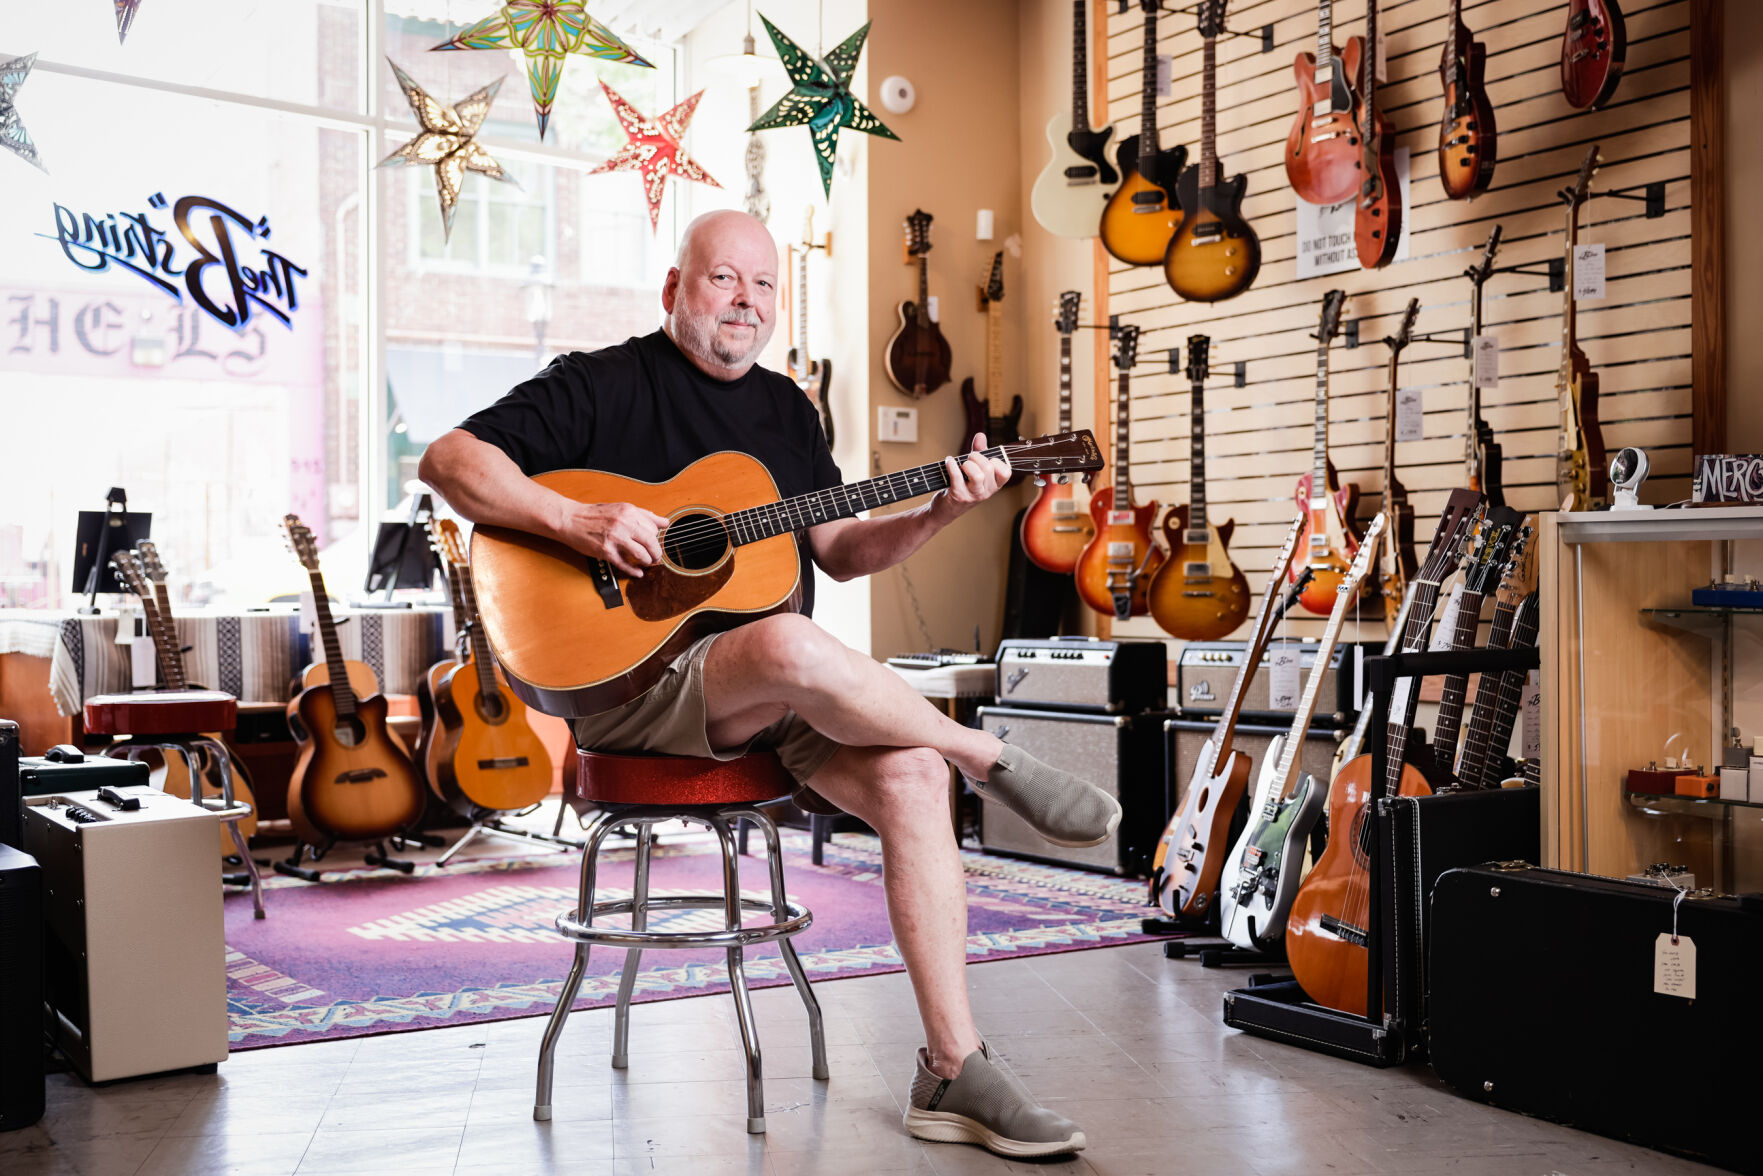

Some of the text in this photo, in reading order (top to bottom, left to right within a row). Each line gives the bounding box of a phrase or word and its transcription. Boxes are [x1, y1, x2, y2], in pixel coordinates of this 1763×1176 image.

[1313, 237, 1326, 250] NOT
[1328, 232, 1352, 247] TOUCH
[1314, 250, 1345, 266] WITHOUT
